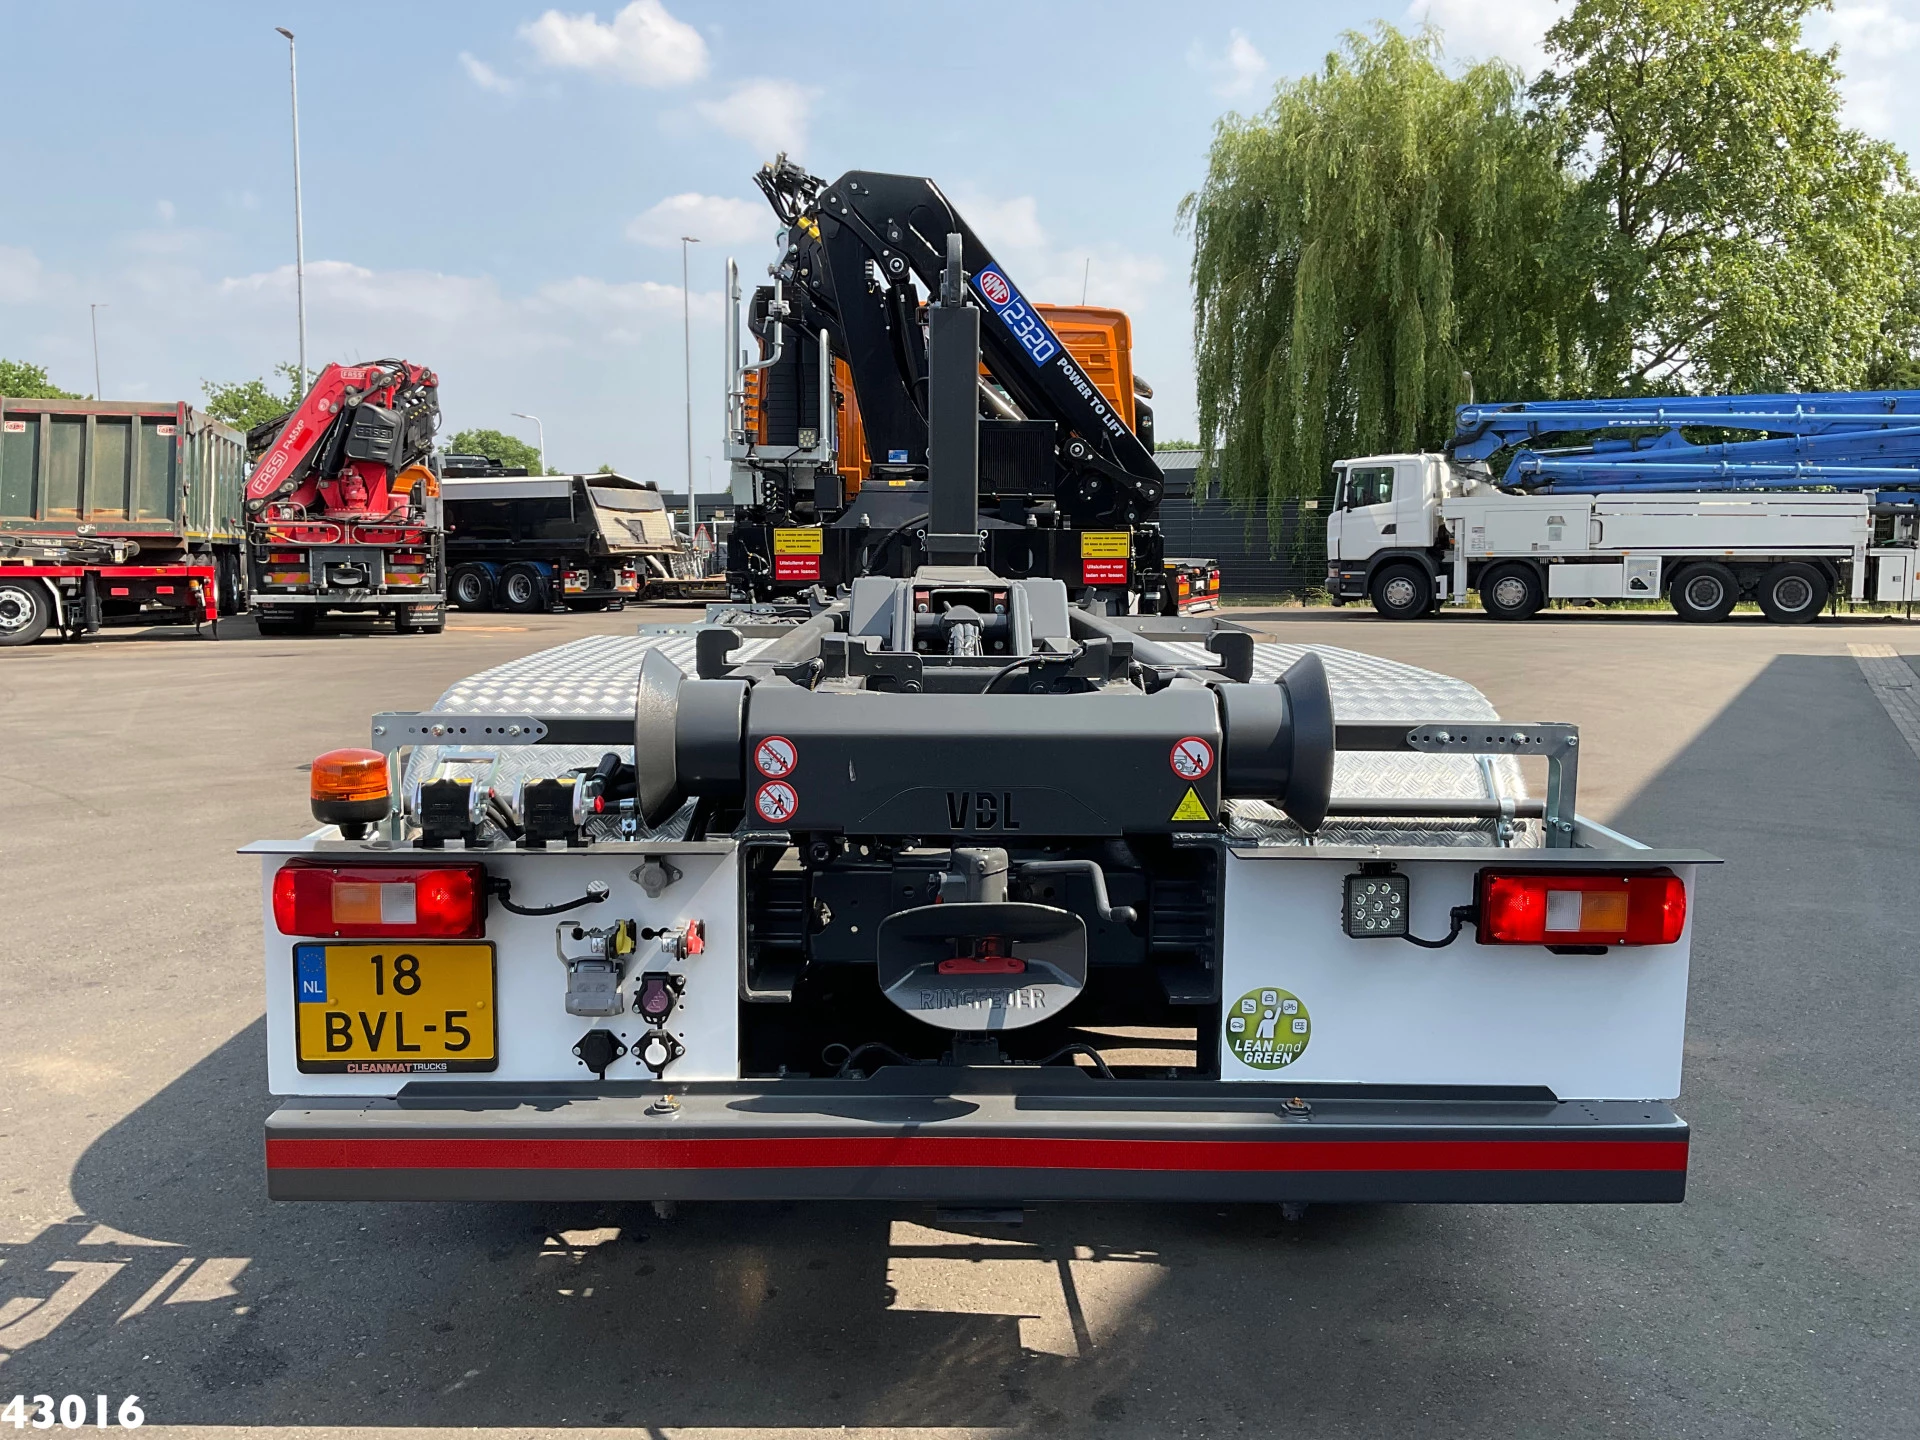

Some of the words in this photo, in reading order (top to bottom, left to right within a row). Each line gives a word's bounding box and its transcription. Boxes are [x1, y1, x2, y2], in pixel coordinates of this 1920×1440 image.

[983, 274, 1007, 300] HMF
[1002, 302, 1055, 362] 2320
[1056, 357, 1093, 400] POWER
[1089, 396, 1106, 414] TO
[1102, 413, 1126, 437] LIFT
[282, 419, 305, 450] F455XP
[254, 455, 286, 492] FASSI
[945, 791, 1020, 831] VDL
[303, 980, 323, 994] NL
[370, 953, 422, 996] 18
[919, 988, 1046, 1010] RINGFEDER
[325, 1010, 472, 1053] BVL-5
[1234, 1039, 1274, 1052] LEAN
[1276, 1040, 1303, 1052] and
[1243, 1051, 1293, 1064] GREEN
